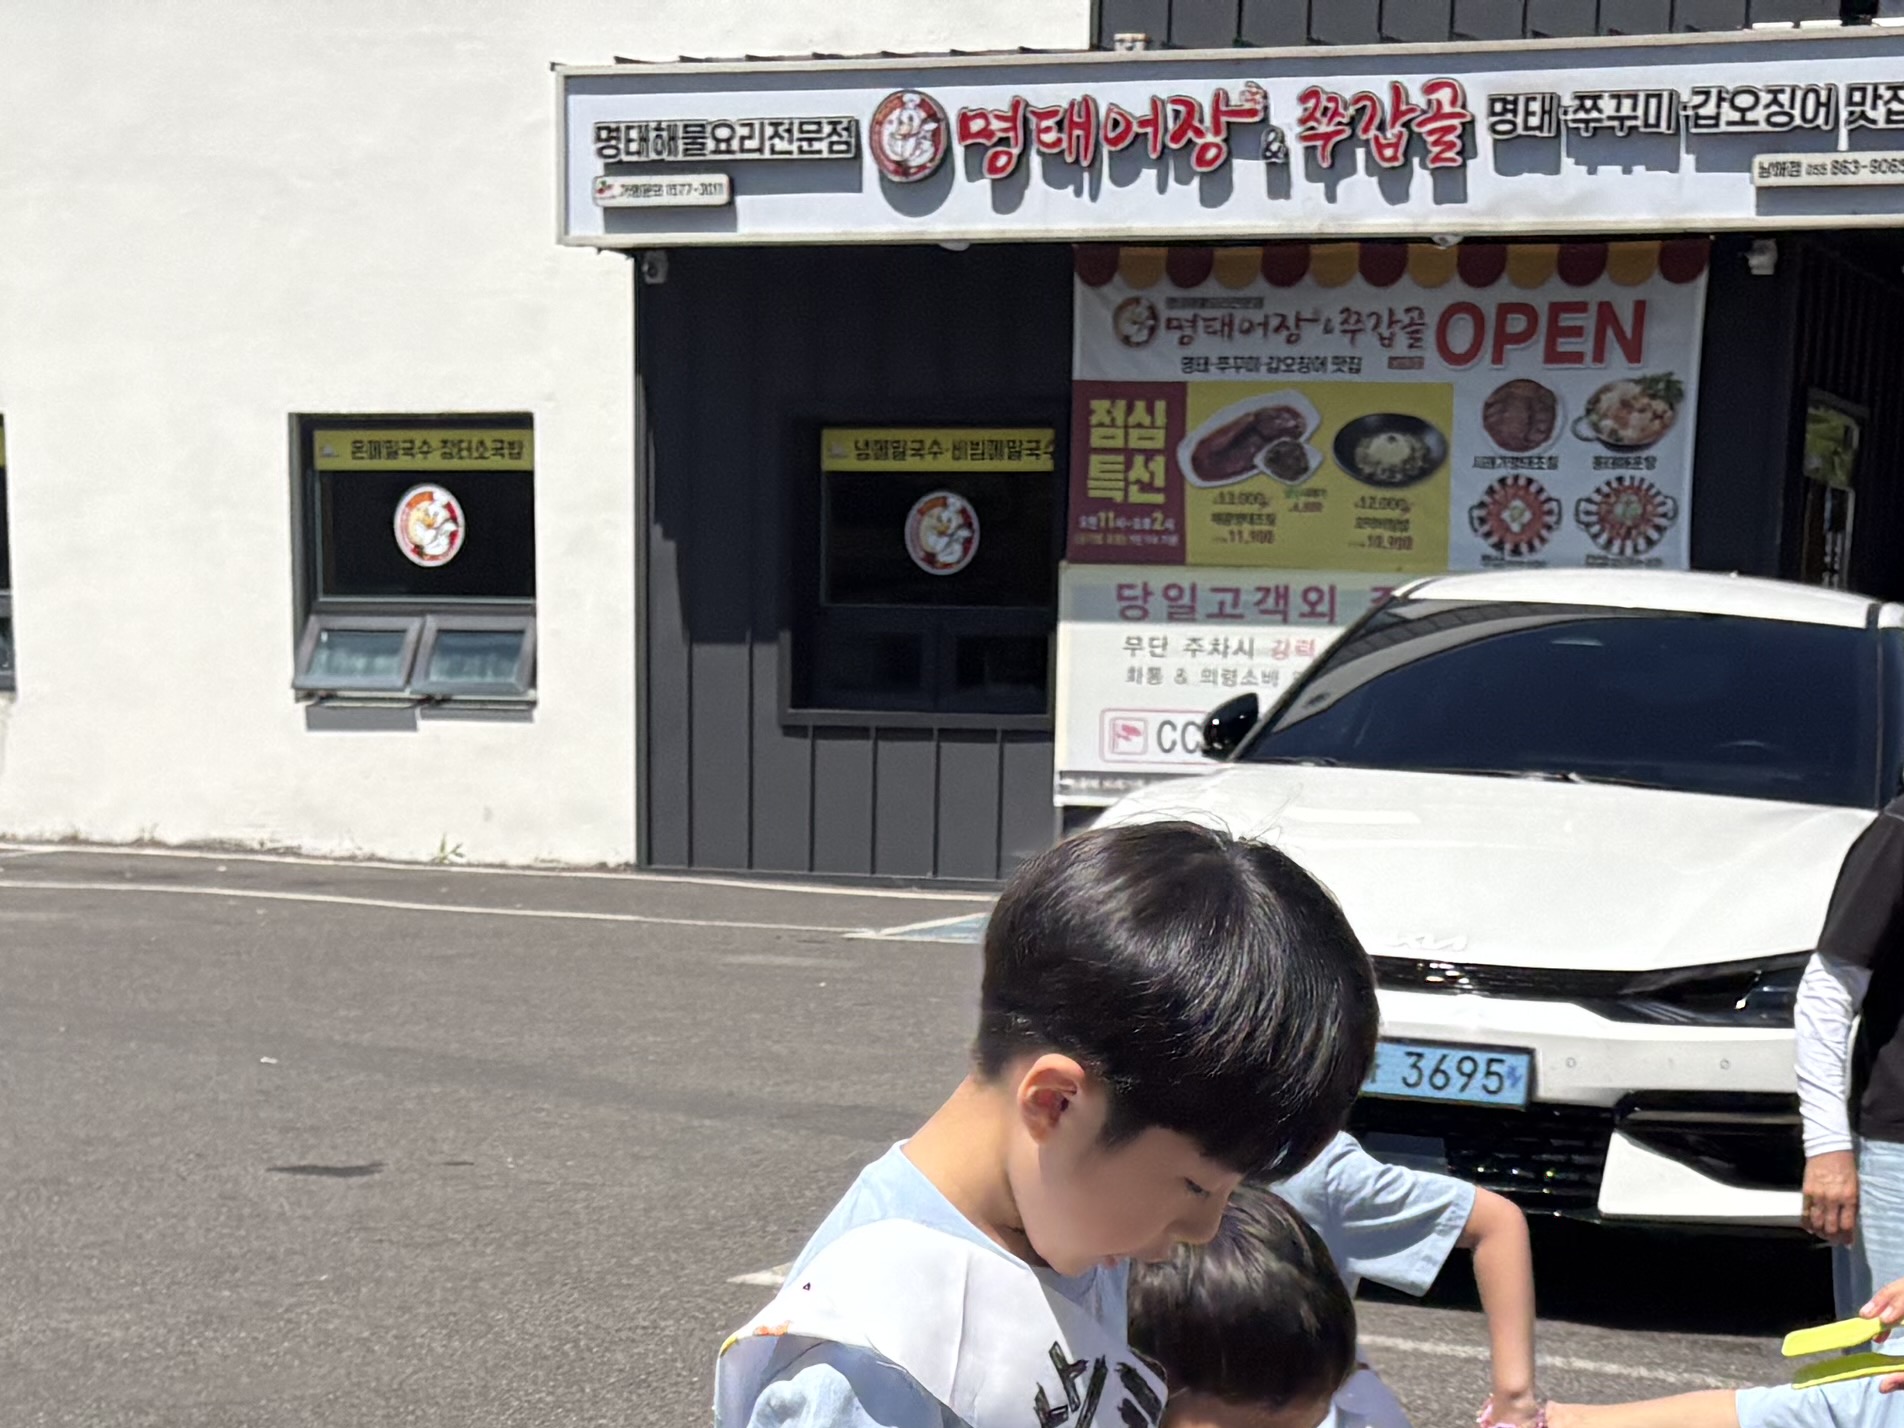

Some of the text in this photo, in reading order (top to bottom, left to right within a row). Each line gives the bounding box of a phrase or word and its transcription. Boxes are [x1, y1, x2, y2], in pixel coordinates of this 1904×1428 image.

[595, 118, 855, 161] 명태해물요리전문점
[956, 82, 1267, 179] 명태어장
[1298, 78, 1472, 169] 쭈갑골
[1165, 308, 1321, 347] 명태어장
[1435, 299, 1647, 369] OPEN
[1331, 355, 1363, 375] 맛집
[1089, 399, 1167, 449] 점심
[1087, 454, 1167, 505] 특선
[1114, 582, 1339, 624] 당일고객외
[1122, 635, 1170, 660] 무단
[1182, 635, 1257, 660] 주차시
[1401, 1050, 1507, 1096] 3695
